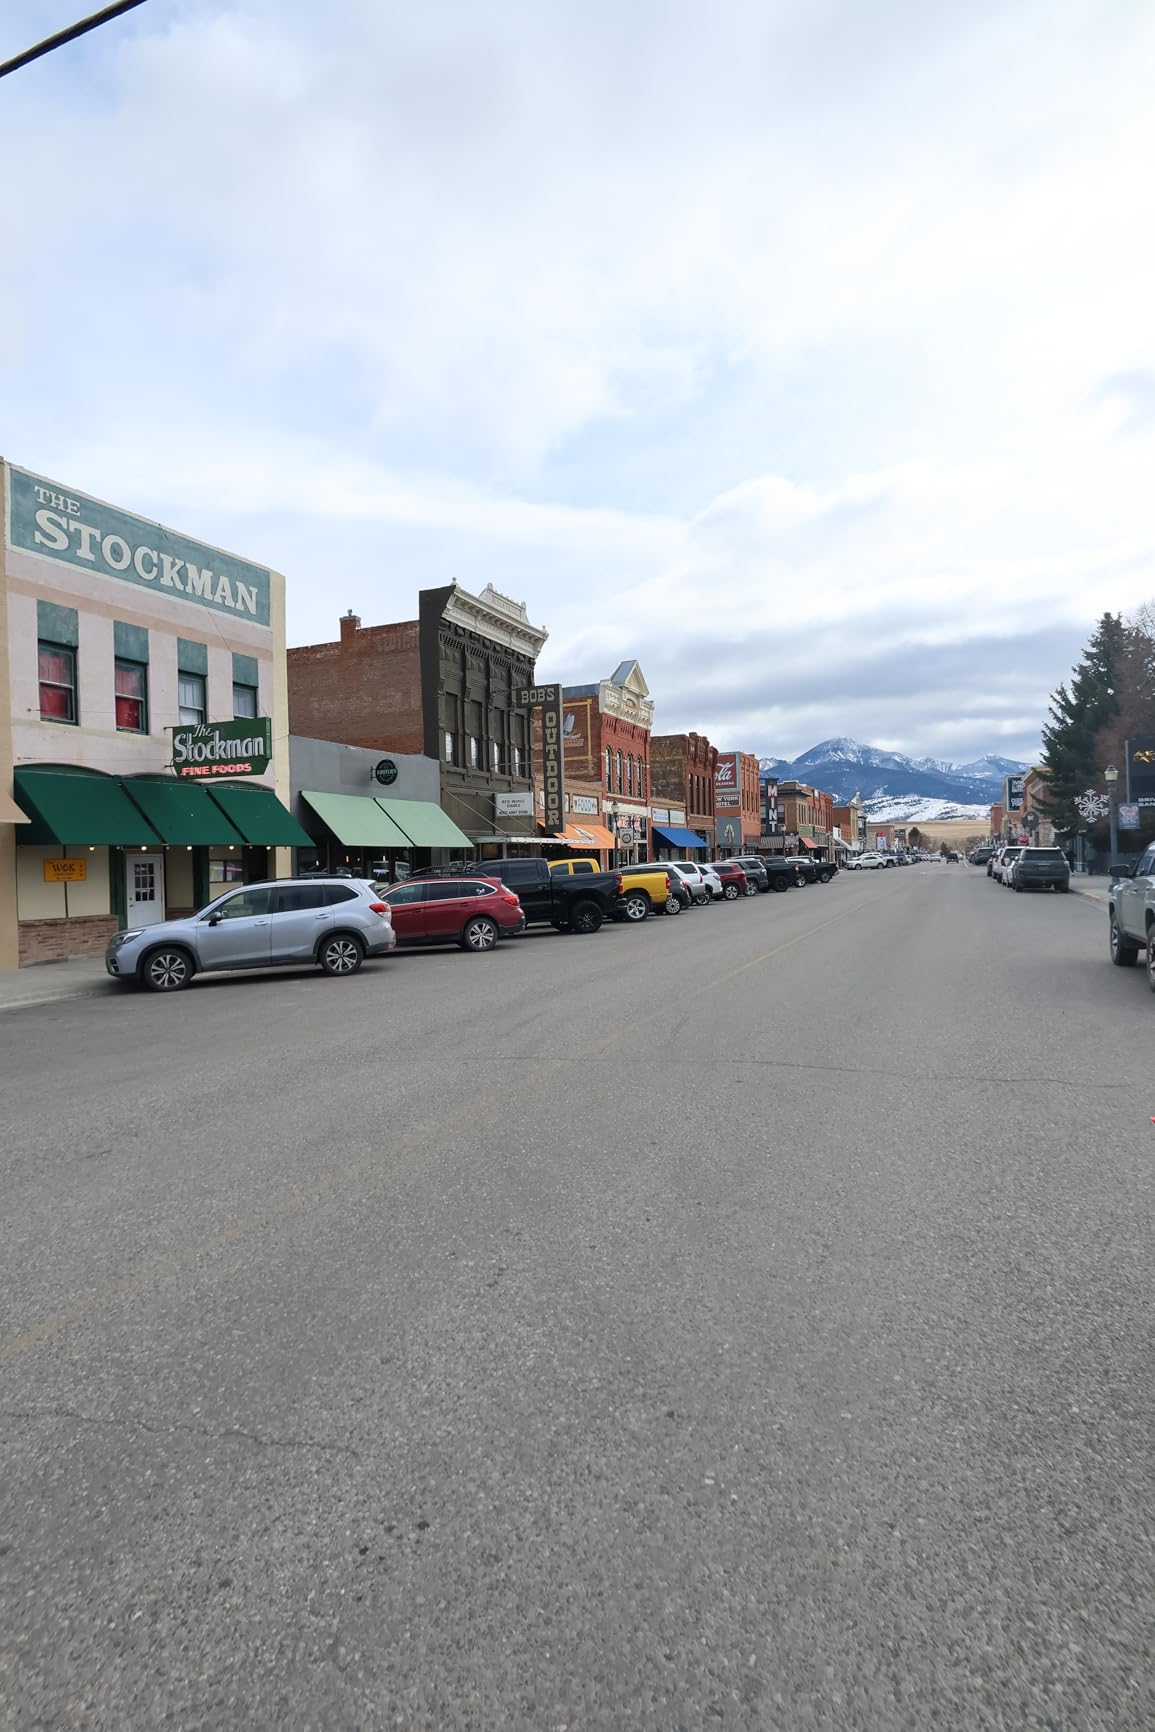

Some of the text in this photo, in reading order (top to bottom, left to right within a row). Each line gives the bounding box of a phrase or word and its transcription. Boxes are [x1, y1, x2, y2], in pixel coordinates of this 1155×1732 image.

[34, 485, 80, 517] THE
[34, 509, 258, 615] STOCKMAN
[521, 687, 555, 704] BOB'S
[173, 730, 265, 763] Stockman
[193, 724, 214, 738] The
[180, 763, 252, 776] FINE FOODS
[545, 711, 560, 825] OUTDOOR
[767, 784, 778, 833] MINT
[52, 863, 76, 872] WOK
